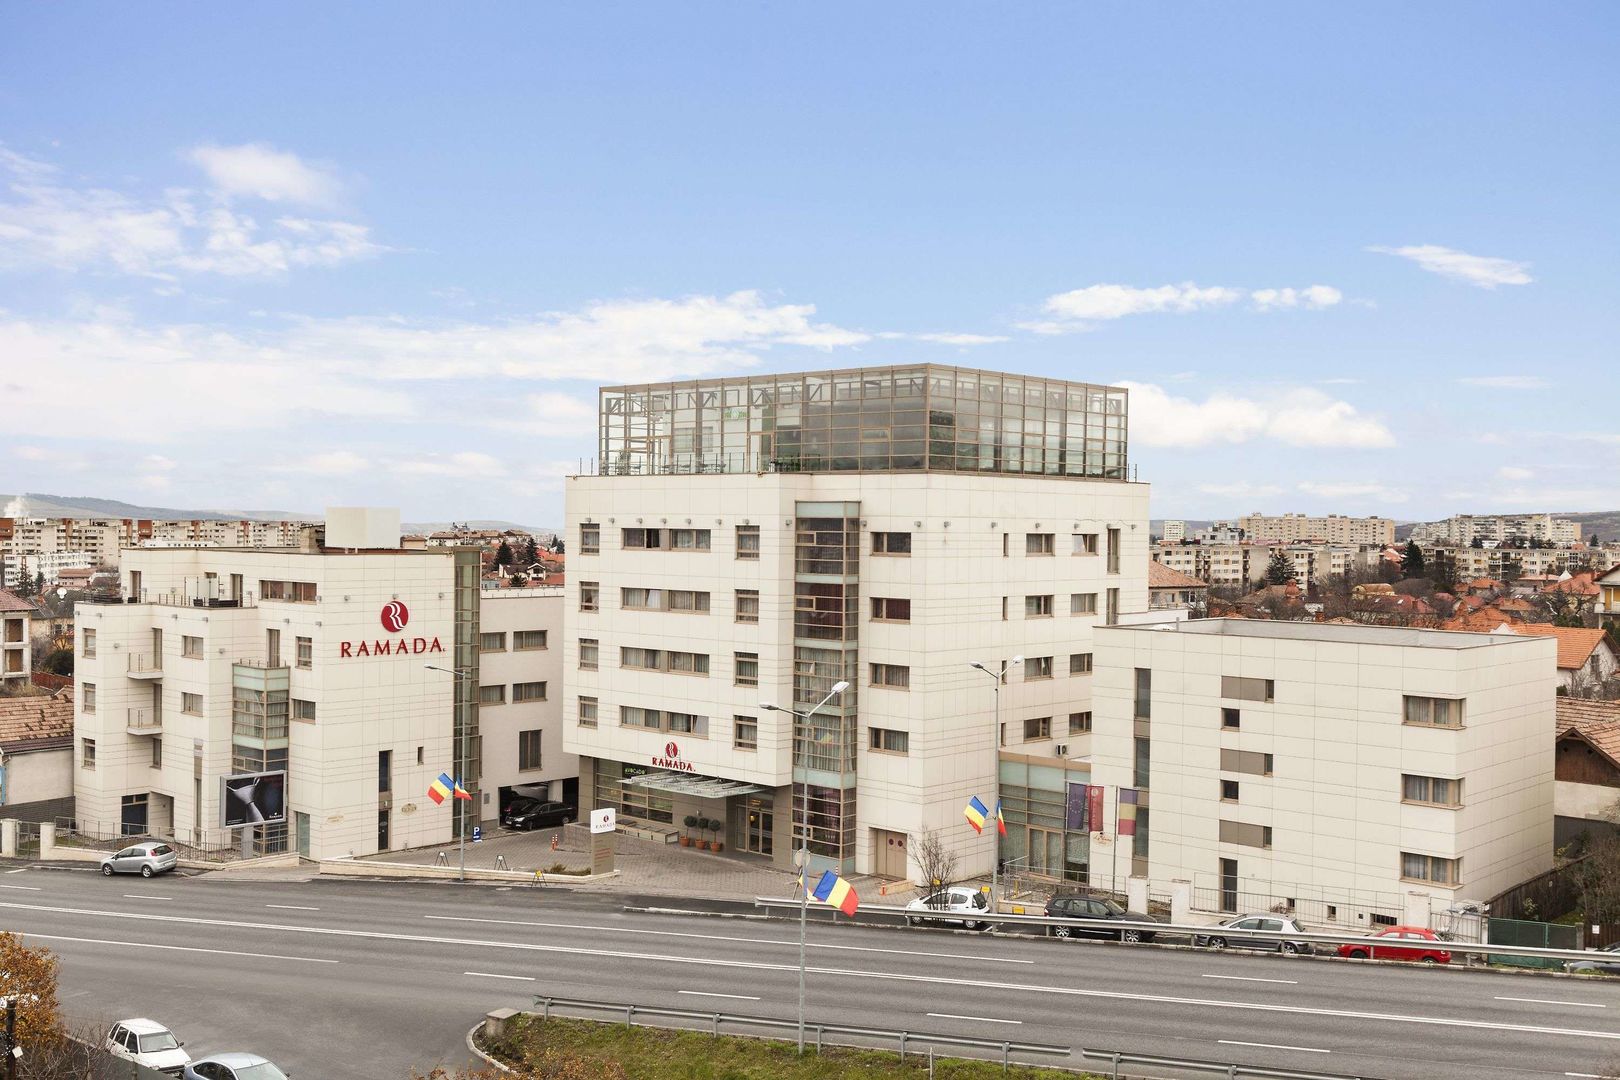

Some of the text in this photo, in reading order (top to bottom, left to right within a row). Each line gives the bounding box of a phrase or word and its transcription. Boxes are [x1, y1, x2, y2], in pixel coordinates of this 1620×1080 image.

[341, 637, 442, 658] RAMADA
[652, 757, 693, 772] RAMADA
[474, 827, 479, 835] P
